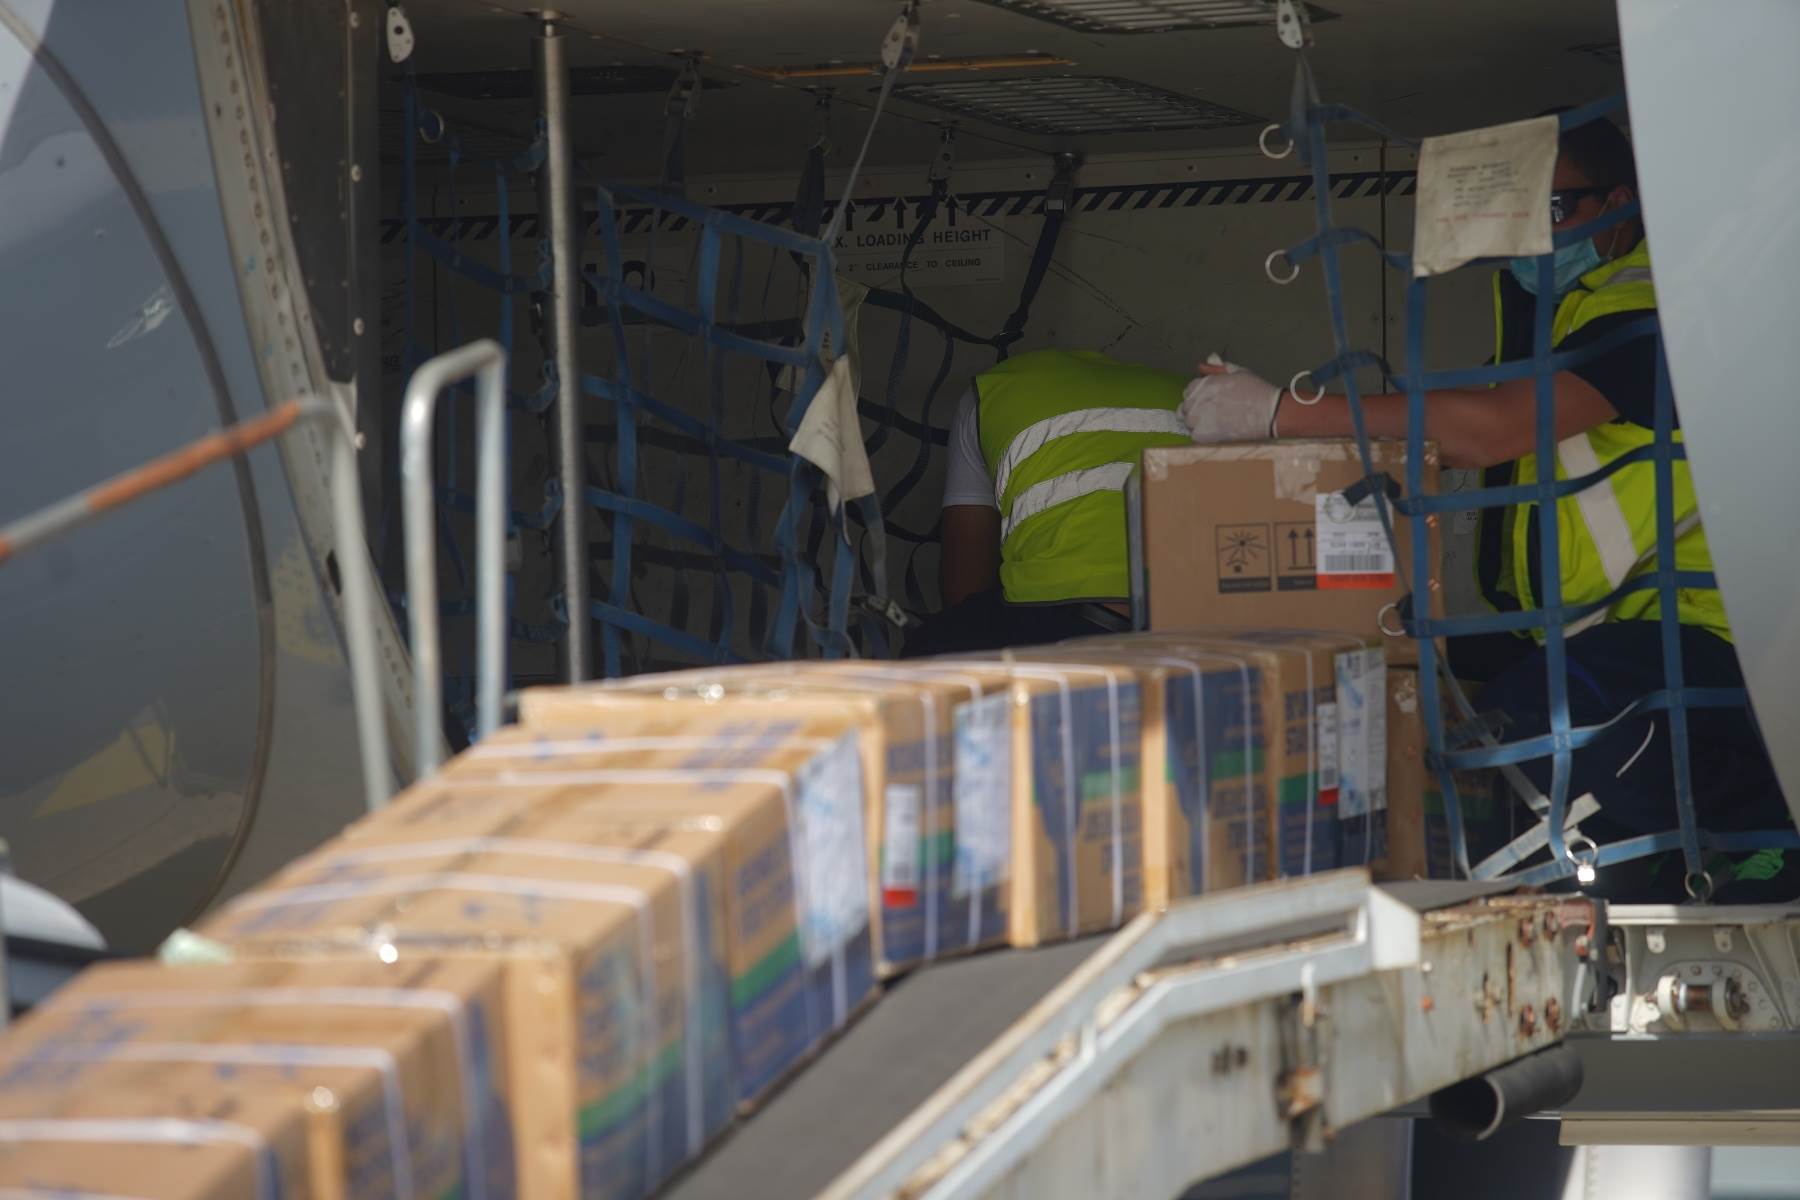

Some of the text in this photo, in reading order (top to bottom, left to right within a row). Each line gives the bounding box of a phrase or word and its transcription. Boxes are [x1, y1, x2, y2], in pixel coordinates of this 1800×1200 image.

[857, 232, 924, 247] LOADING
[933, 229, 991, 243] HEIGHT
[866, 261, 919, 271] CLEARANCE
[926, 260, 938, 268] TO
[945, 258, 981, 268] CEILING
